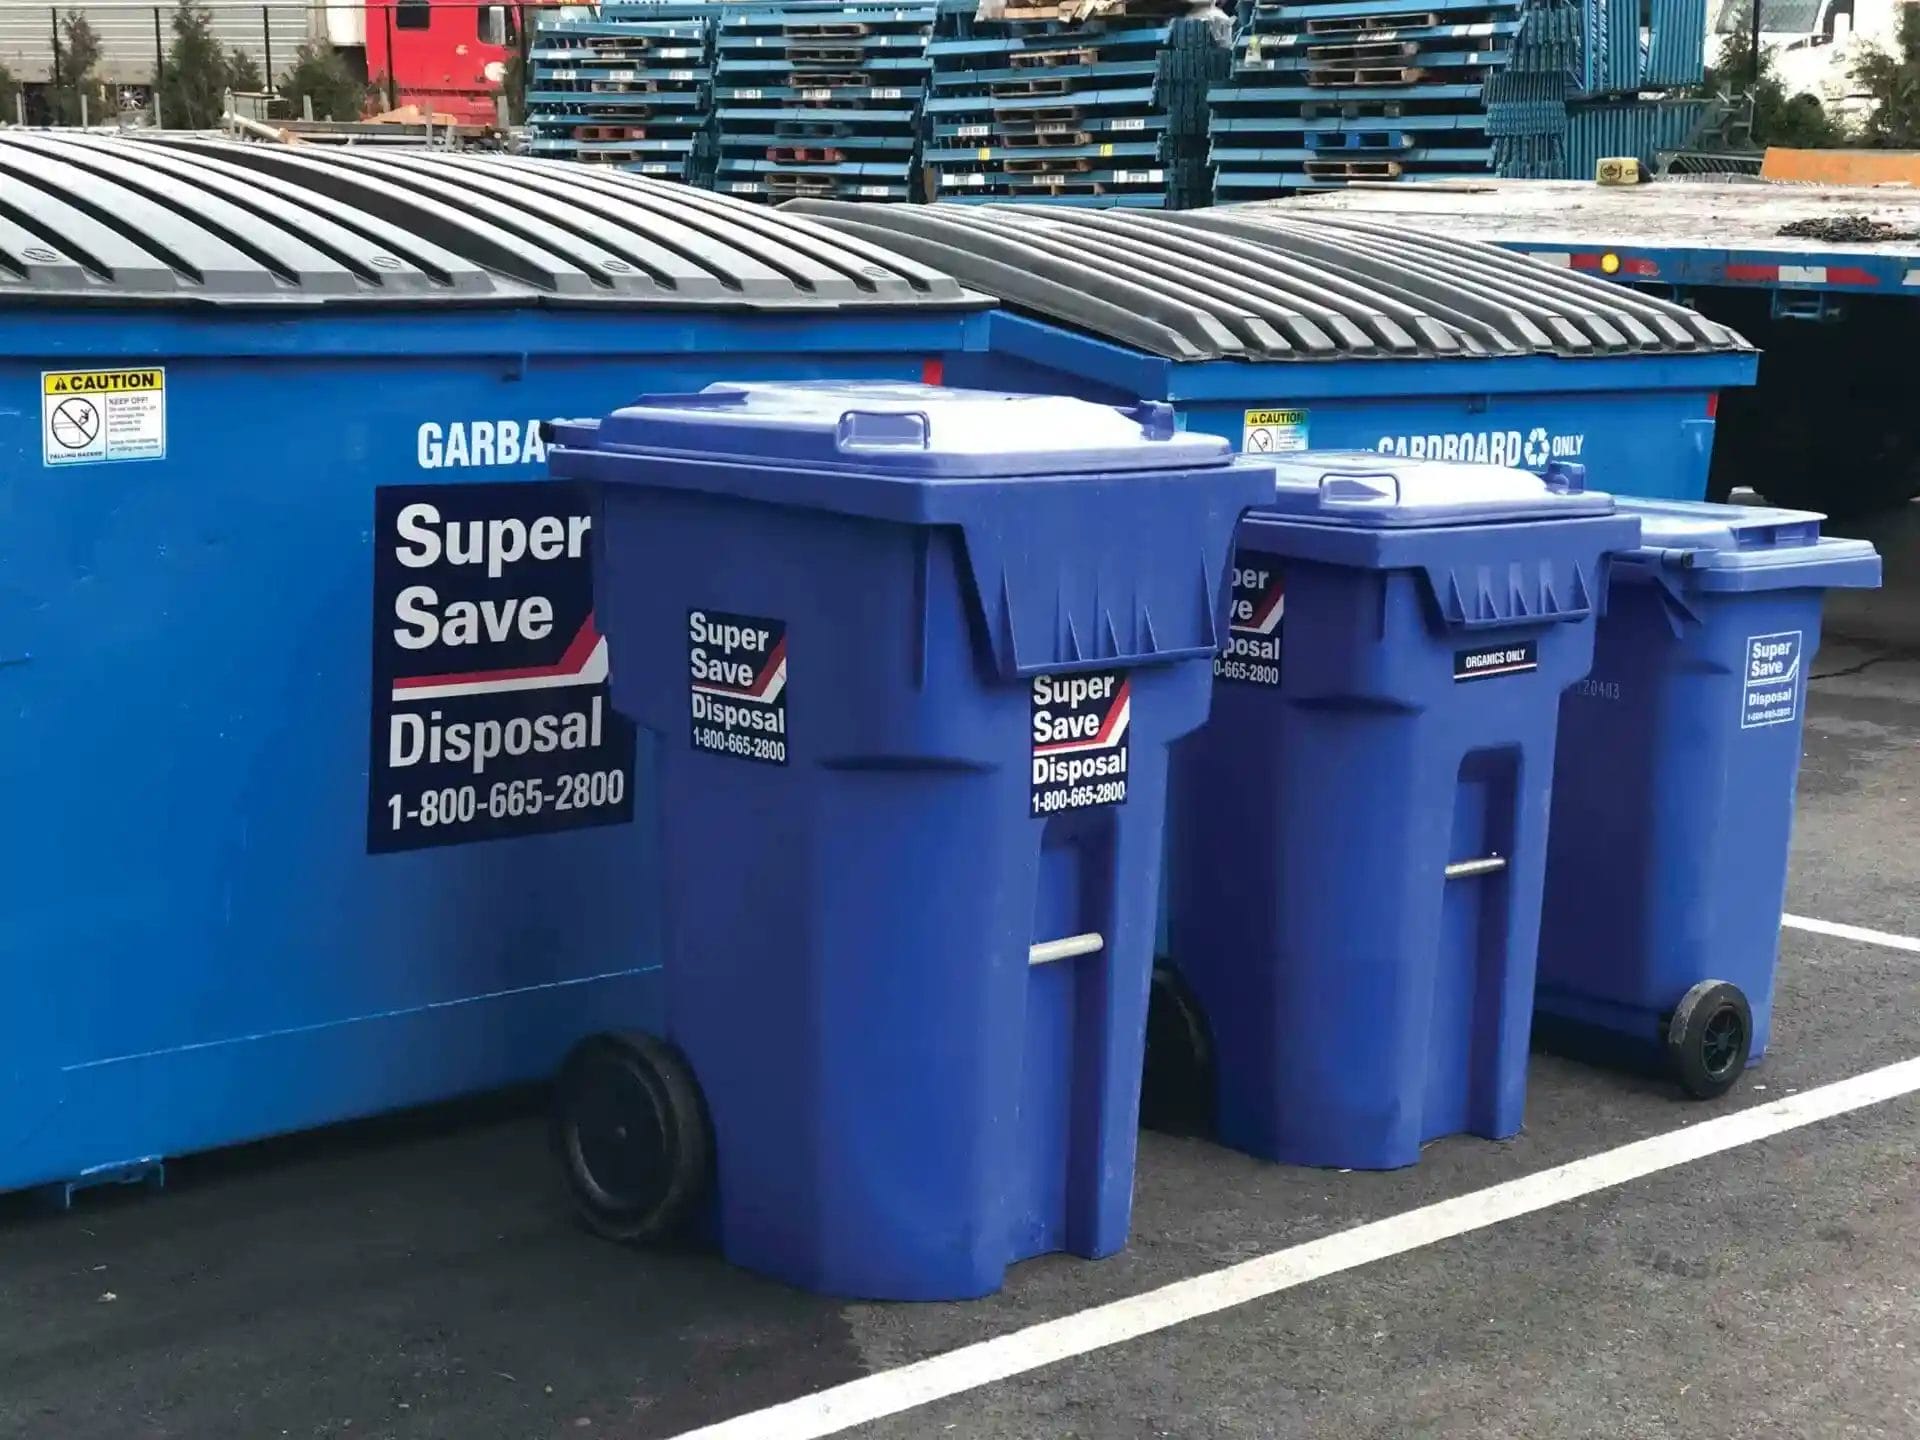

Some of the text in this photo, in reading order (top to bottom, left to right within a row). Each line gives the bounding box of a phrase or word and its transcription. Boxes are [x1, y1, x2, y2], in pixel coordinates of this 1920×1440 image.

[70, 373, 154, 390] CAUTION
[418, 420, 565, 469] GARBA
[1552, 435, 1584, 457] ONLY
[396, 503, 591, 578] Super
[393, 585, 553, 650] Save
[690, 611, 769, 655] Super
[691, 648, 753, 687] Save
[1466, 648, 1526, 668] ORGANICS ONLY
[1751, 660, 1783, 677] Save
[1752, 642, 1792, 661] Super
[1033, 675, 1114, 709] Super
[1749, 687, 1792, 707] Disposal
[692, 692, 785, 734] Disposal
[1033, 710, 1100, 742] Save
[389, 696, 602, 774] Disposal
[693, 726, 786, 762] 1-800-665-2800
[1033, 747, 1126, 786] Disposal
[387, 769, 625, 830] 1-800-665-2800
[1032, 781, 1126, 813] 1-800-665-2800
